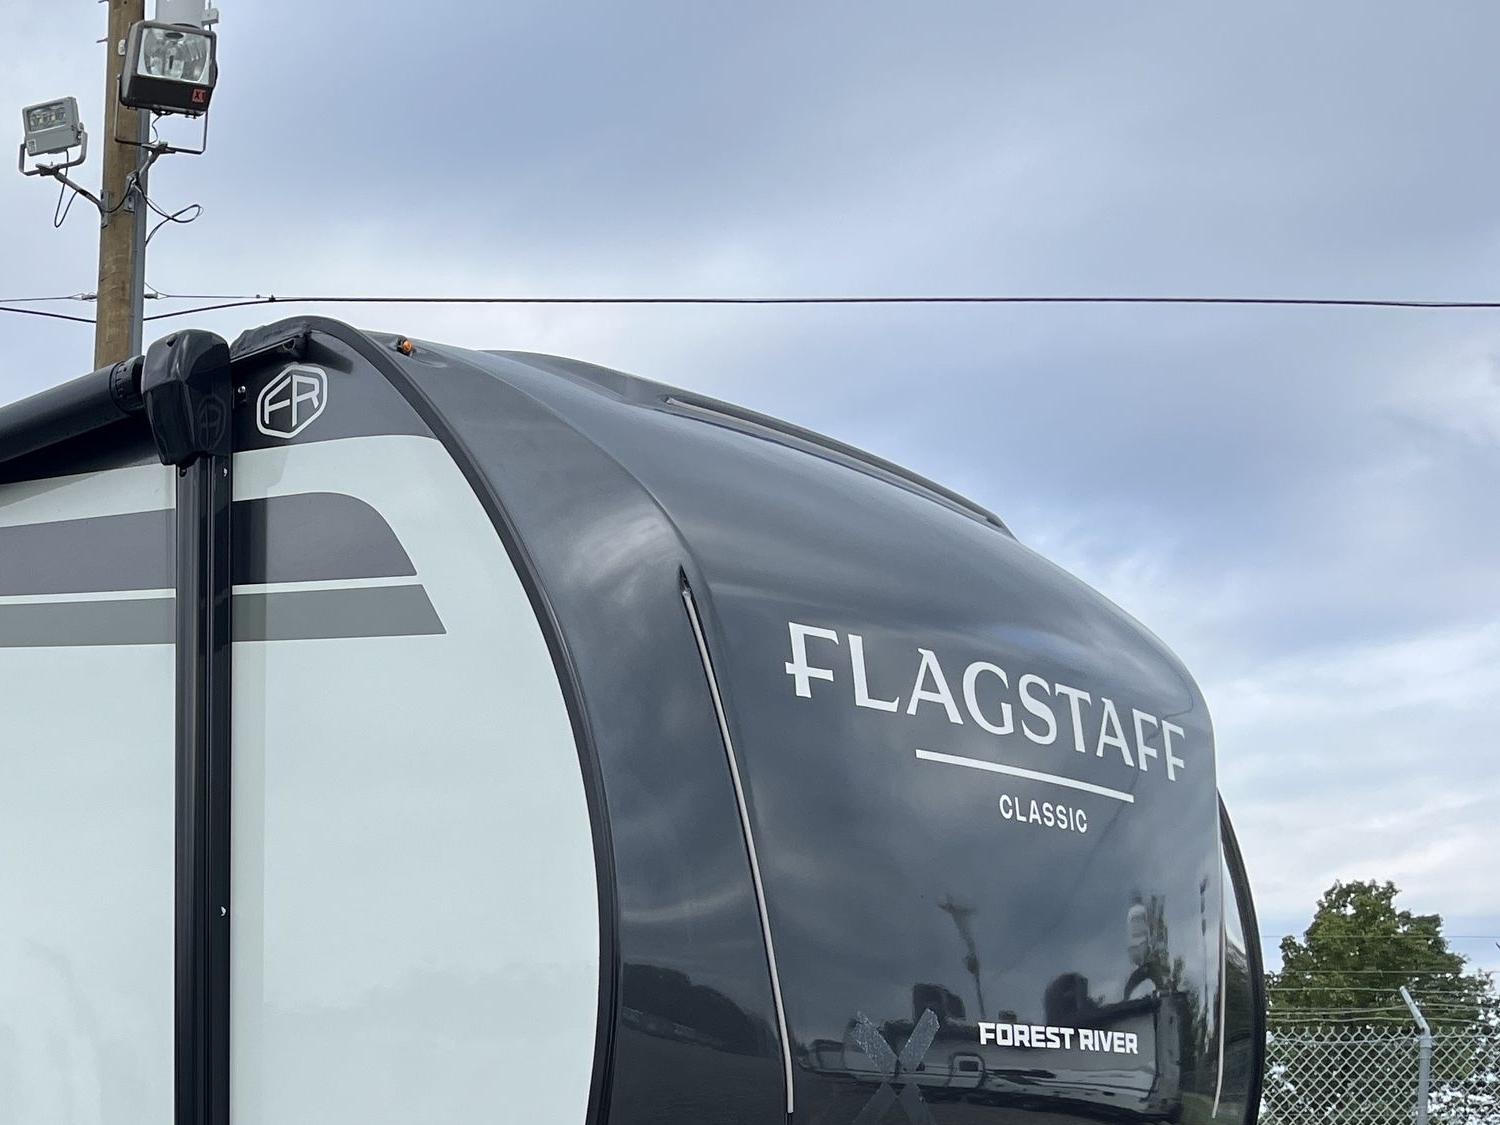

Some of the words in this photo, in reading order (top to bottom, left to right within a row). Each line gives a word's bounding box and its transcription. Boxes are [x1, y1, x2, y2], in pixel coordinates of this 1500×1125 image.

[784, 621, 1186, 782] FLAGSTAFF
[999, 794, 1089, 833] CLASSIC
[978, 1021, 1073, 1050] FOREST
[1078, 1027, 1139, 1055] RIVER
